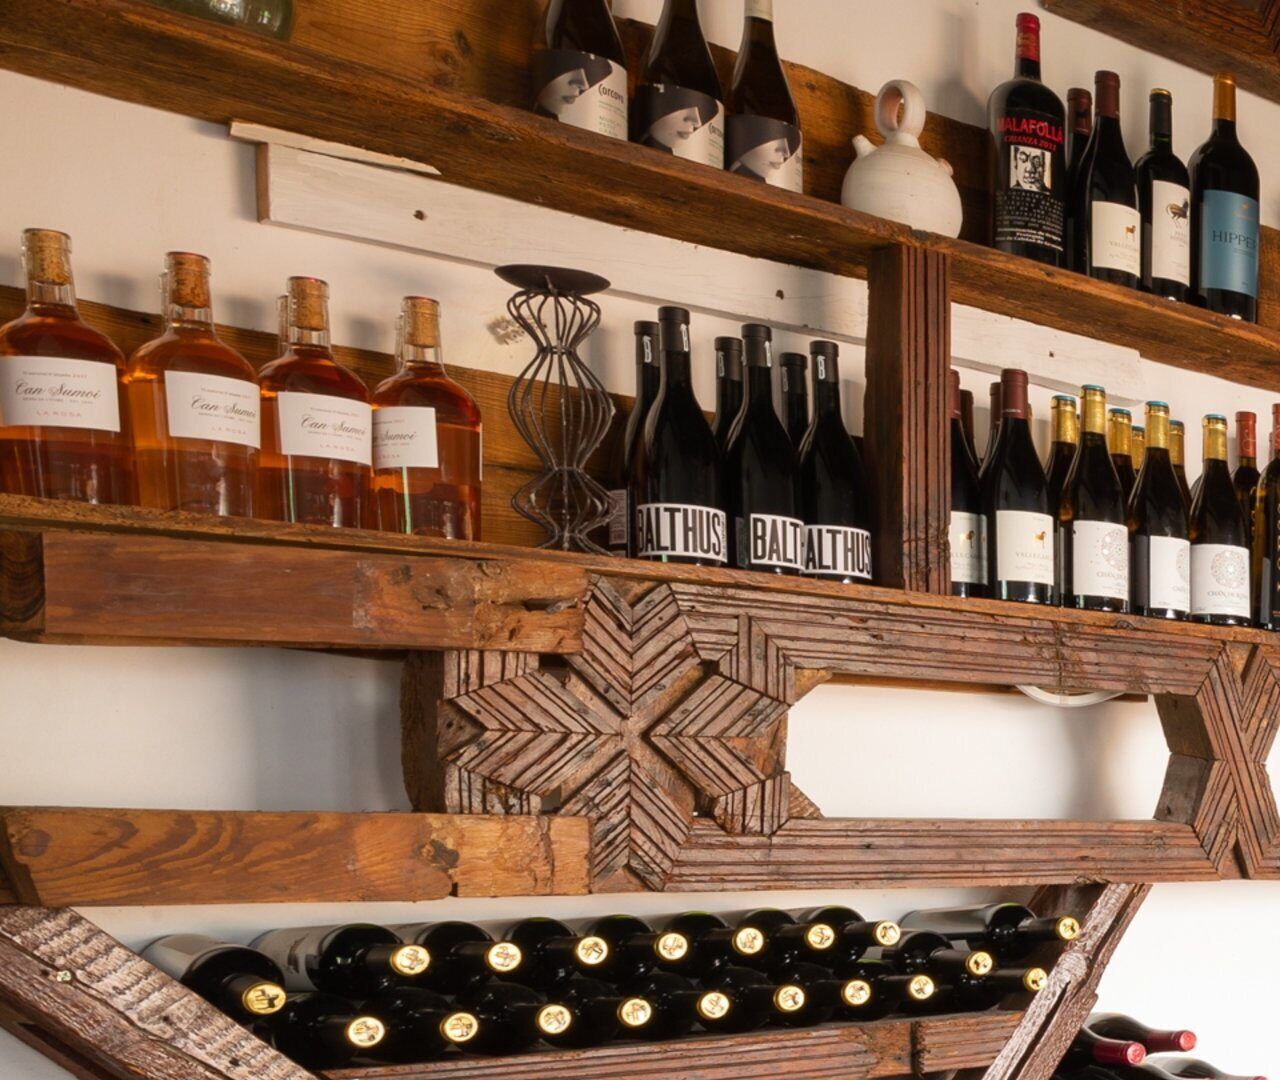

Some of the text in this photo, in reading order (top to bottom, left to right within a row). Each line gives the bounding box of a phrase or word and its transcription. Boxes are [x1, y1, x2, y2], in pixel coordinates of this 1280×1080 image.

[15, 379, 102, 399] Can Sumoi
[191, 395, 219, 411] Can
[301, 414, 329, 430] Can
[637, 507, 721, 557] BALTHUS
[804, 527, 871, 576] ALTHUS
